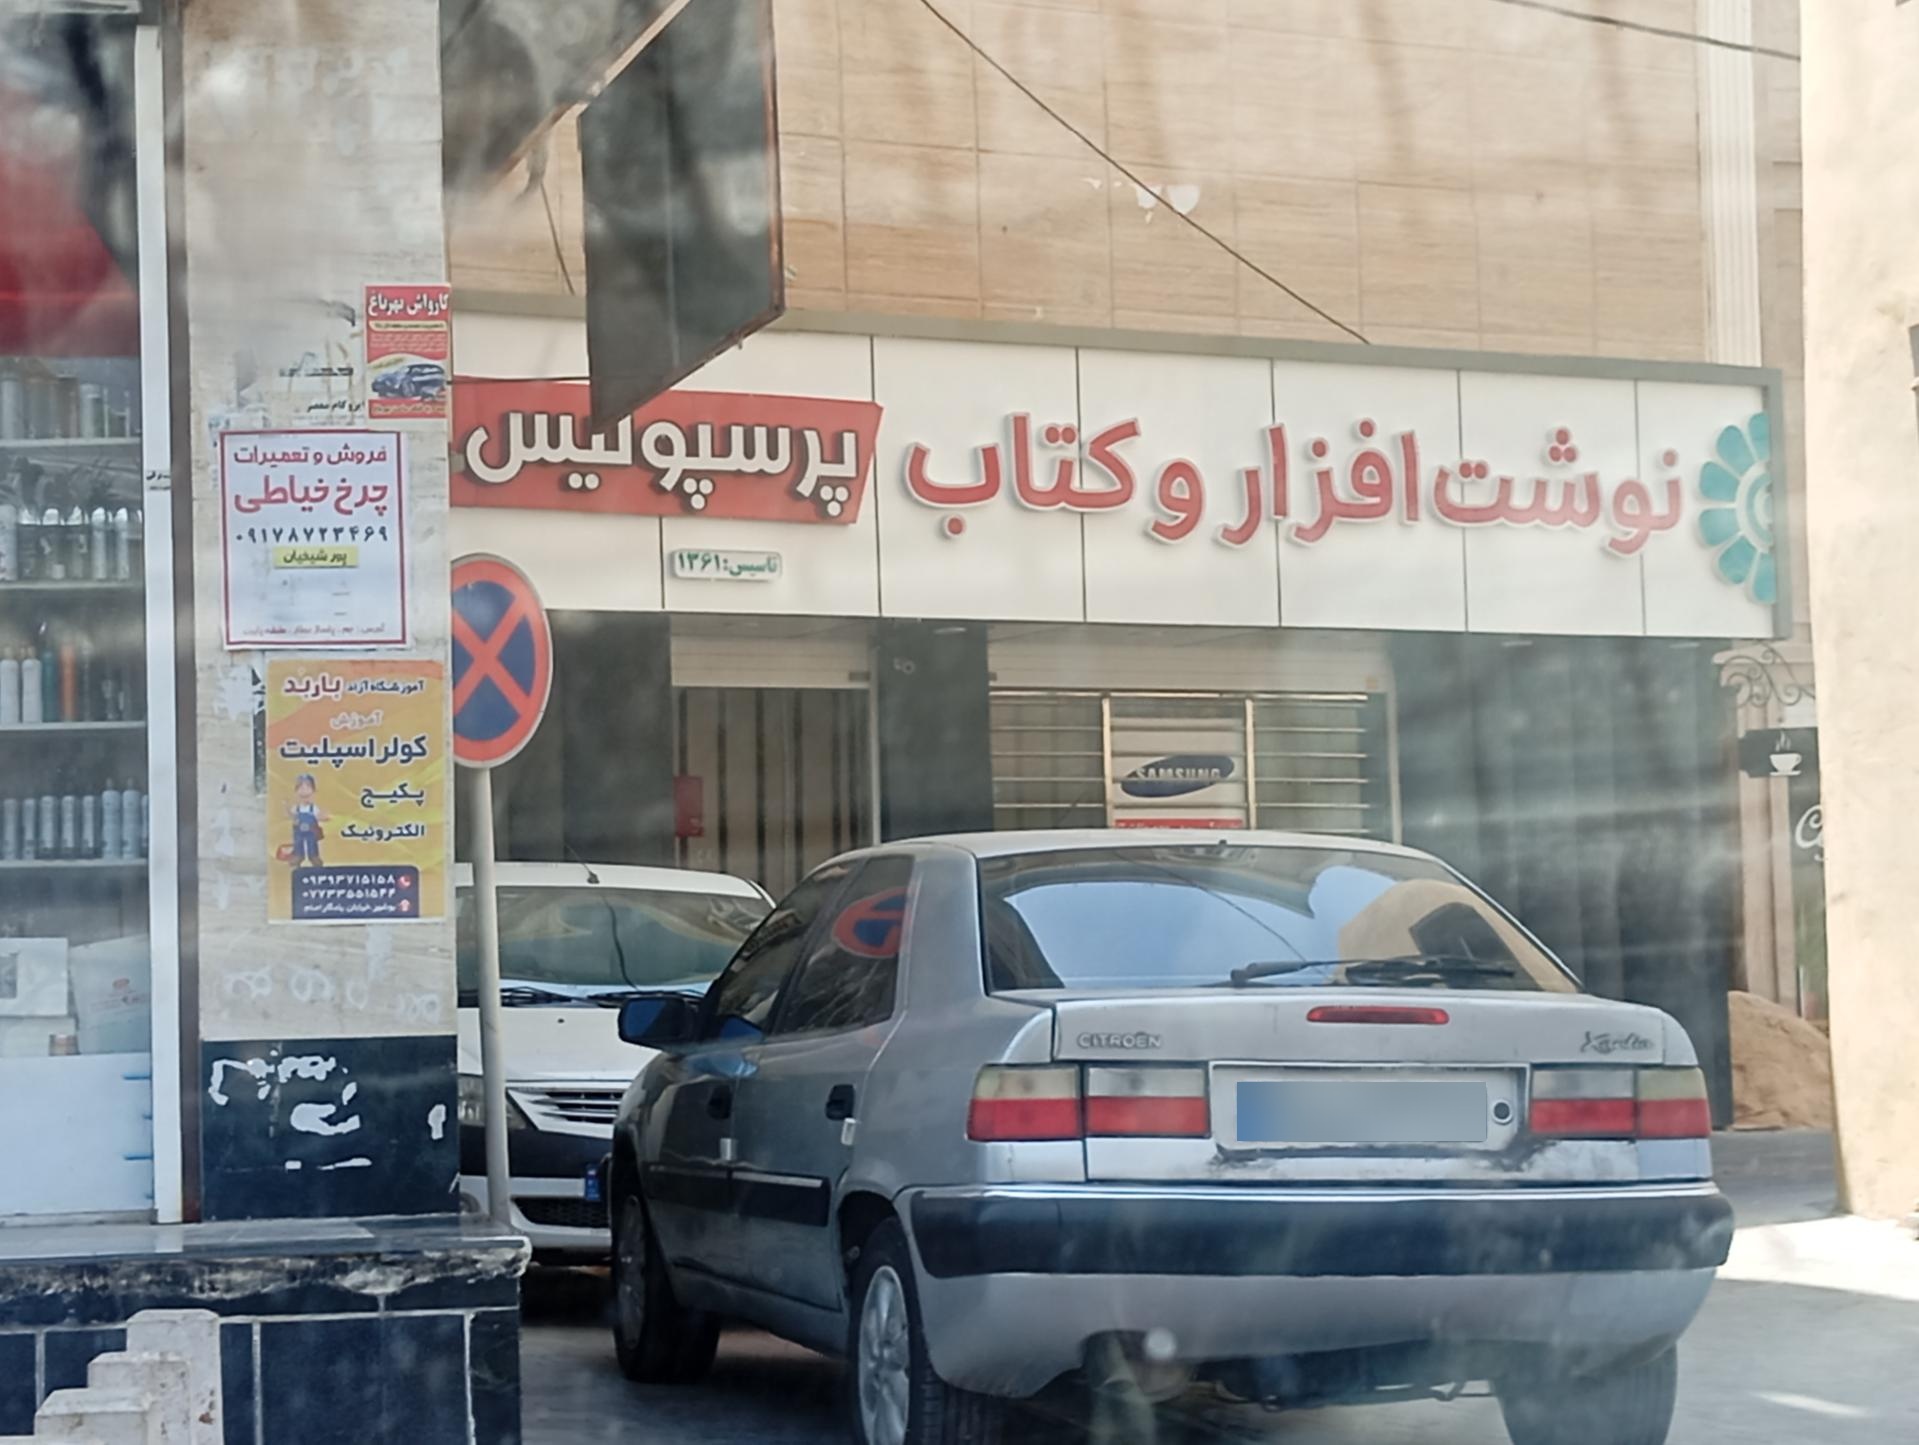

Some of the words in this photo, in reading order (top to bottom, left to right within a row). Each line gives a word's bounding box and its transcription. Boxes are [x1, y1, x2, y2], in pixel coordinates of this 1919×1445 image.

[234, 446, 309, 468] تعمیرات
[313, 451, 323, 466] و
[327, 443, 388, 465] فروش
[904, 411, 1142, 537] کتاب
[1219, 416, 1421, 546] افزار
[234, 475, 330, 514] خیاطی
[334, 478, 389, 516] چرخ
[1148, 458, 1207, 543] و
[1433, 428, 1682, 556] نوشت
[284, 675, 342, 698] باربد
[331, 710, 383, 729] آموزش
[280, 736, 374, 767] اسپلیت
[375, 735, 428, 765] کولر
[360, 783, 425, 808] پکیج
[341, 823, 425, 842] الکترونیک
